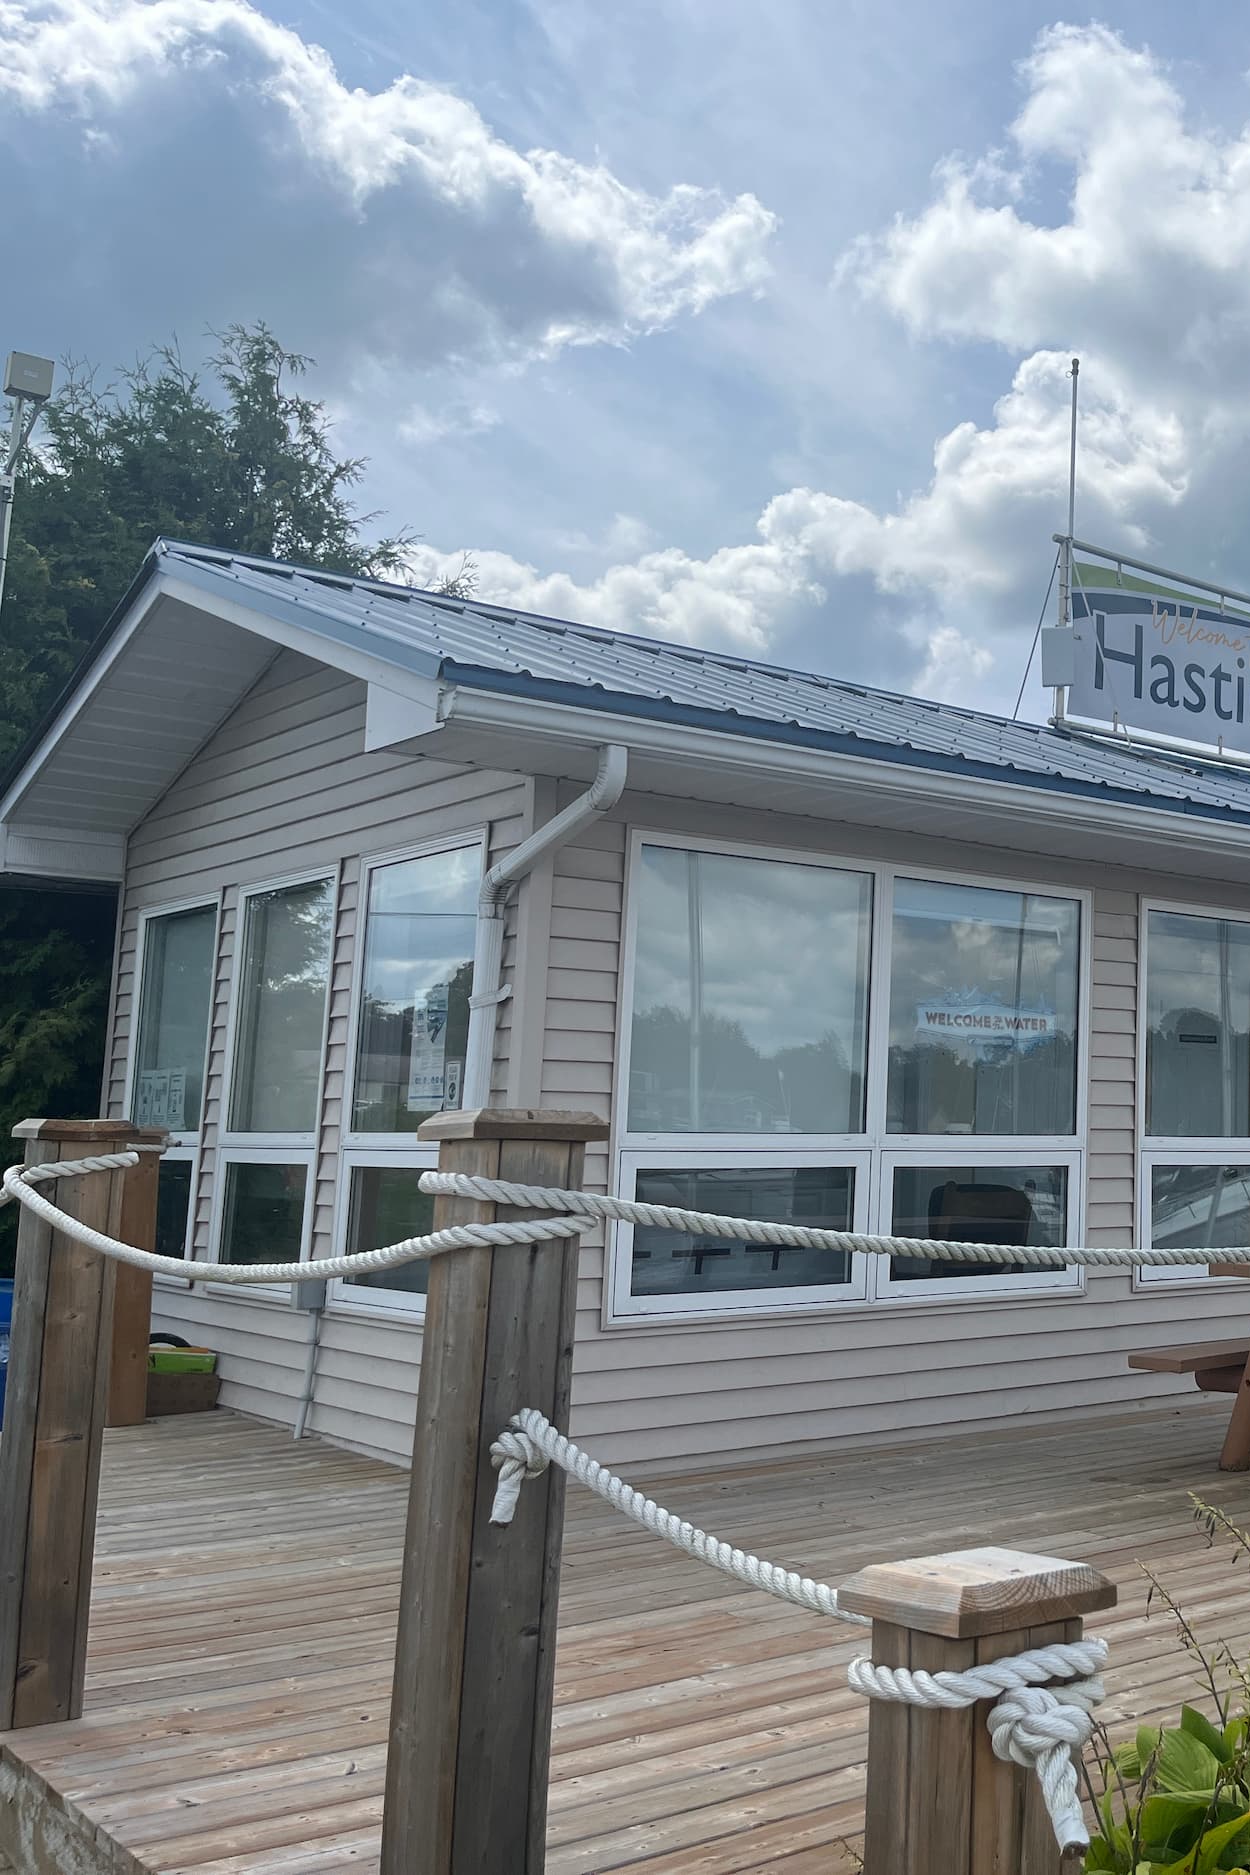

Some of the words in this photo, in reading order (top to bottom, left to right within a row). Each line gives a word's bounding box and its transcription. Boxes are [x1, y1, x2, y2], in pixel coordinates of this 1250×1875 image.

[1150, 599, 1246, 652] Welcome
[925, 1011, 991, 1030] WELCOME
[1005, 1016, 1048, 1032] WATER
